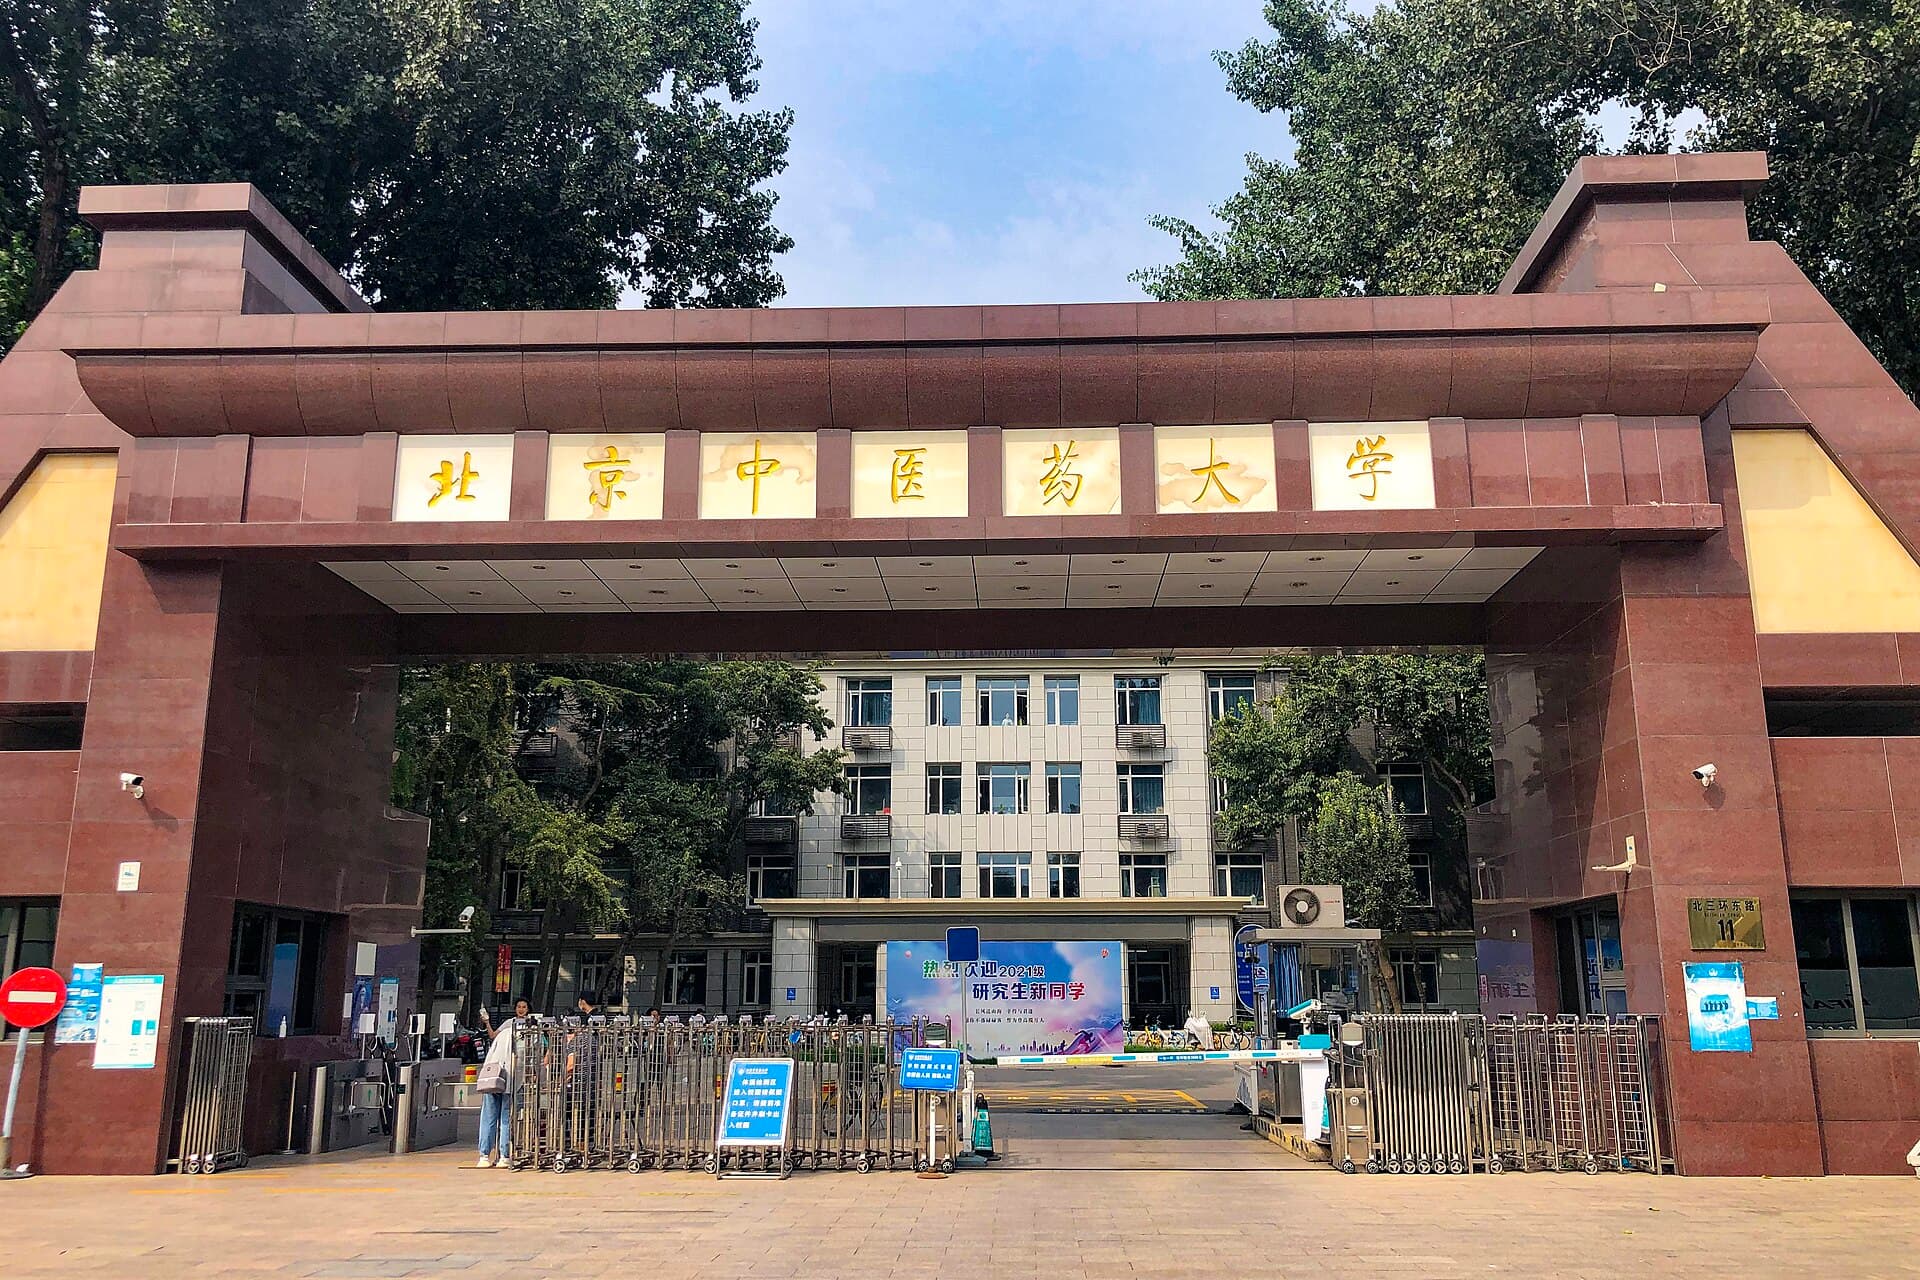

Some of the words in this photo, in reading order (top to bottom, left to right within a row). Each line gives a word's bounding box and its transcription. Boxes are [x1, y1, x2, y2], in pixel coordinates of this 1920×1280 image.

[427, 435, 1394, 515] 北京中医药大学
[1692, 900, 1755, 911] 北三环东路
[1717, 919, 1735, 941] 11
[972, 983, 1085, 1001] 研究生新同学
